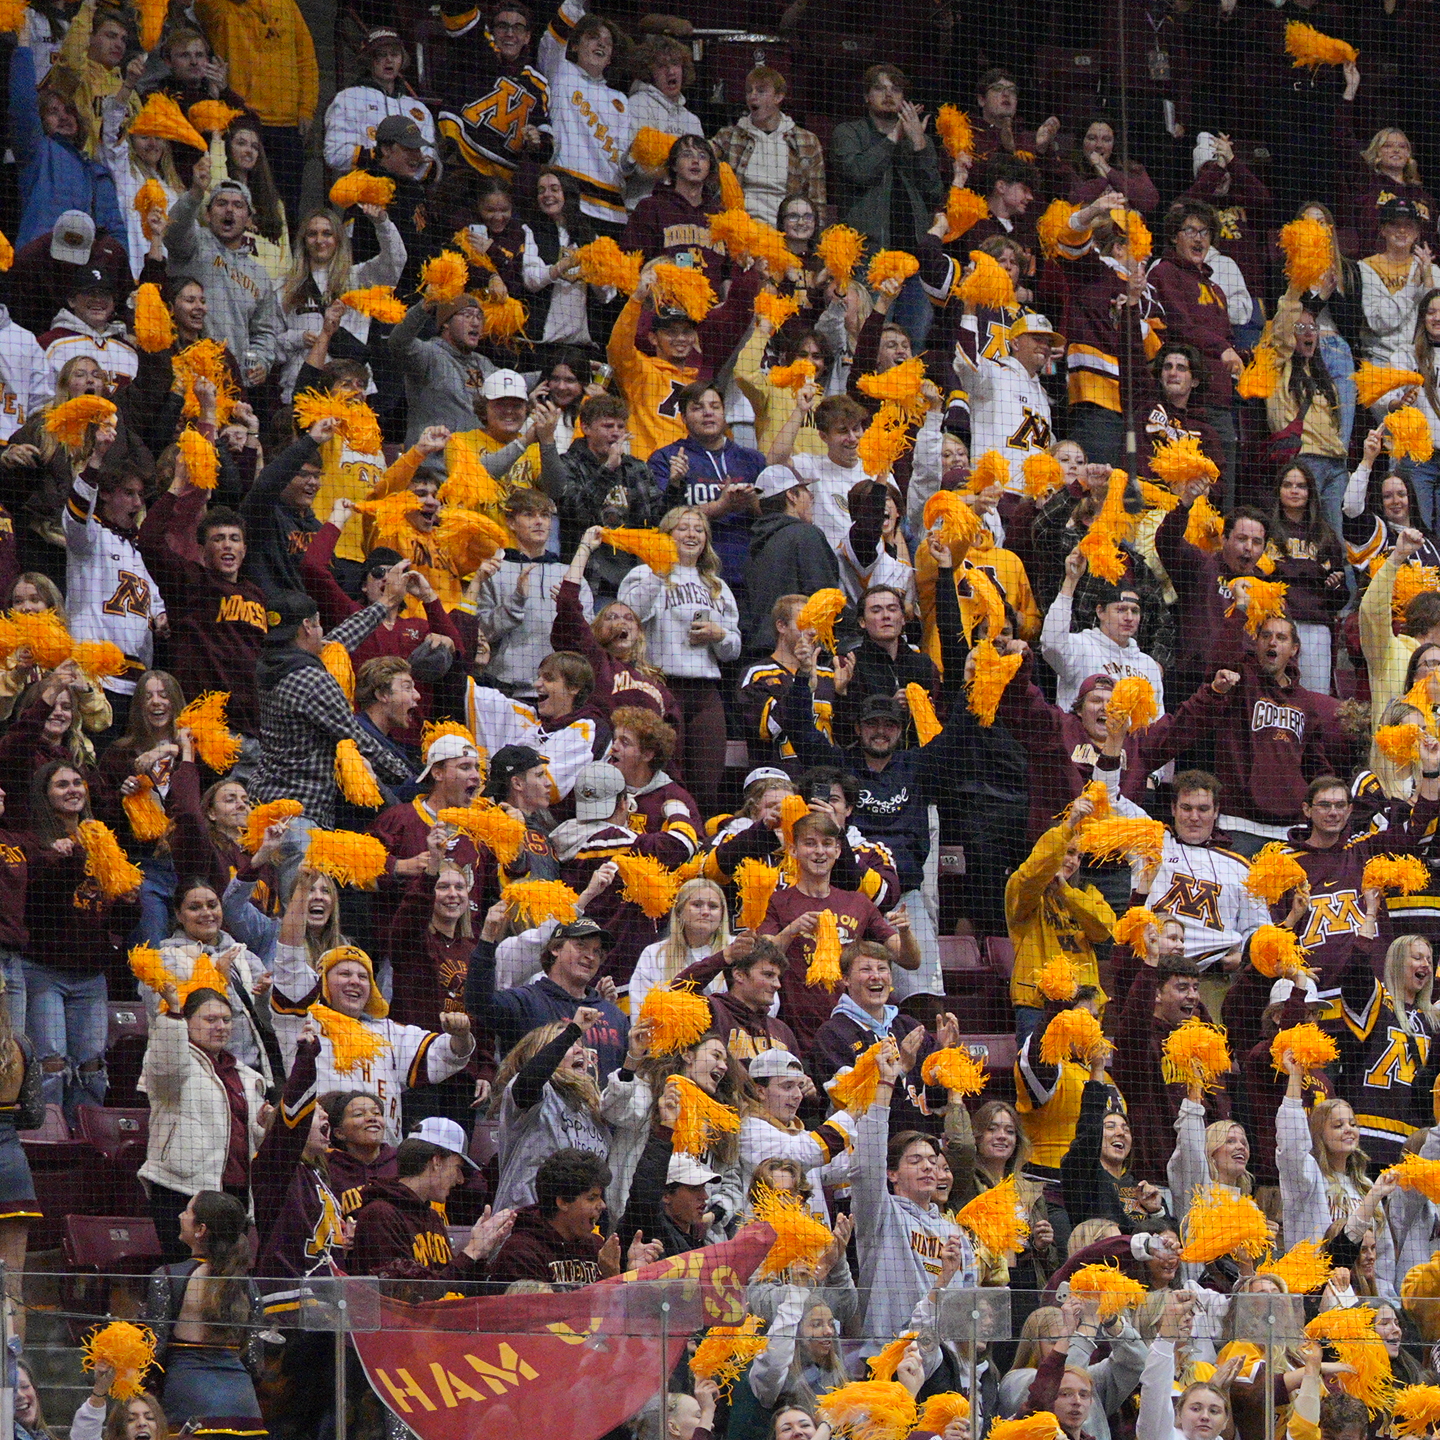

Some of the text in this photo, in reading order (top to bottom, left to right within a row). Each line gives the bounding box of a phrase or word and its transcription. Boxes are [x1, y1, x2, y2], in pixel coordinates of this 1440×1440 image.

[462, 76, 537, 151] M
[1007, 406, 1051, 452] M
[104, 570, 152, 617] M
[871, 806, 897, 814] GOLF
[1151, 873, 1225, 932] M
[1299, 888, 1378, 947] M
[375, 1341, 540, 1413] HAM
